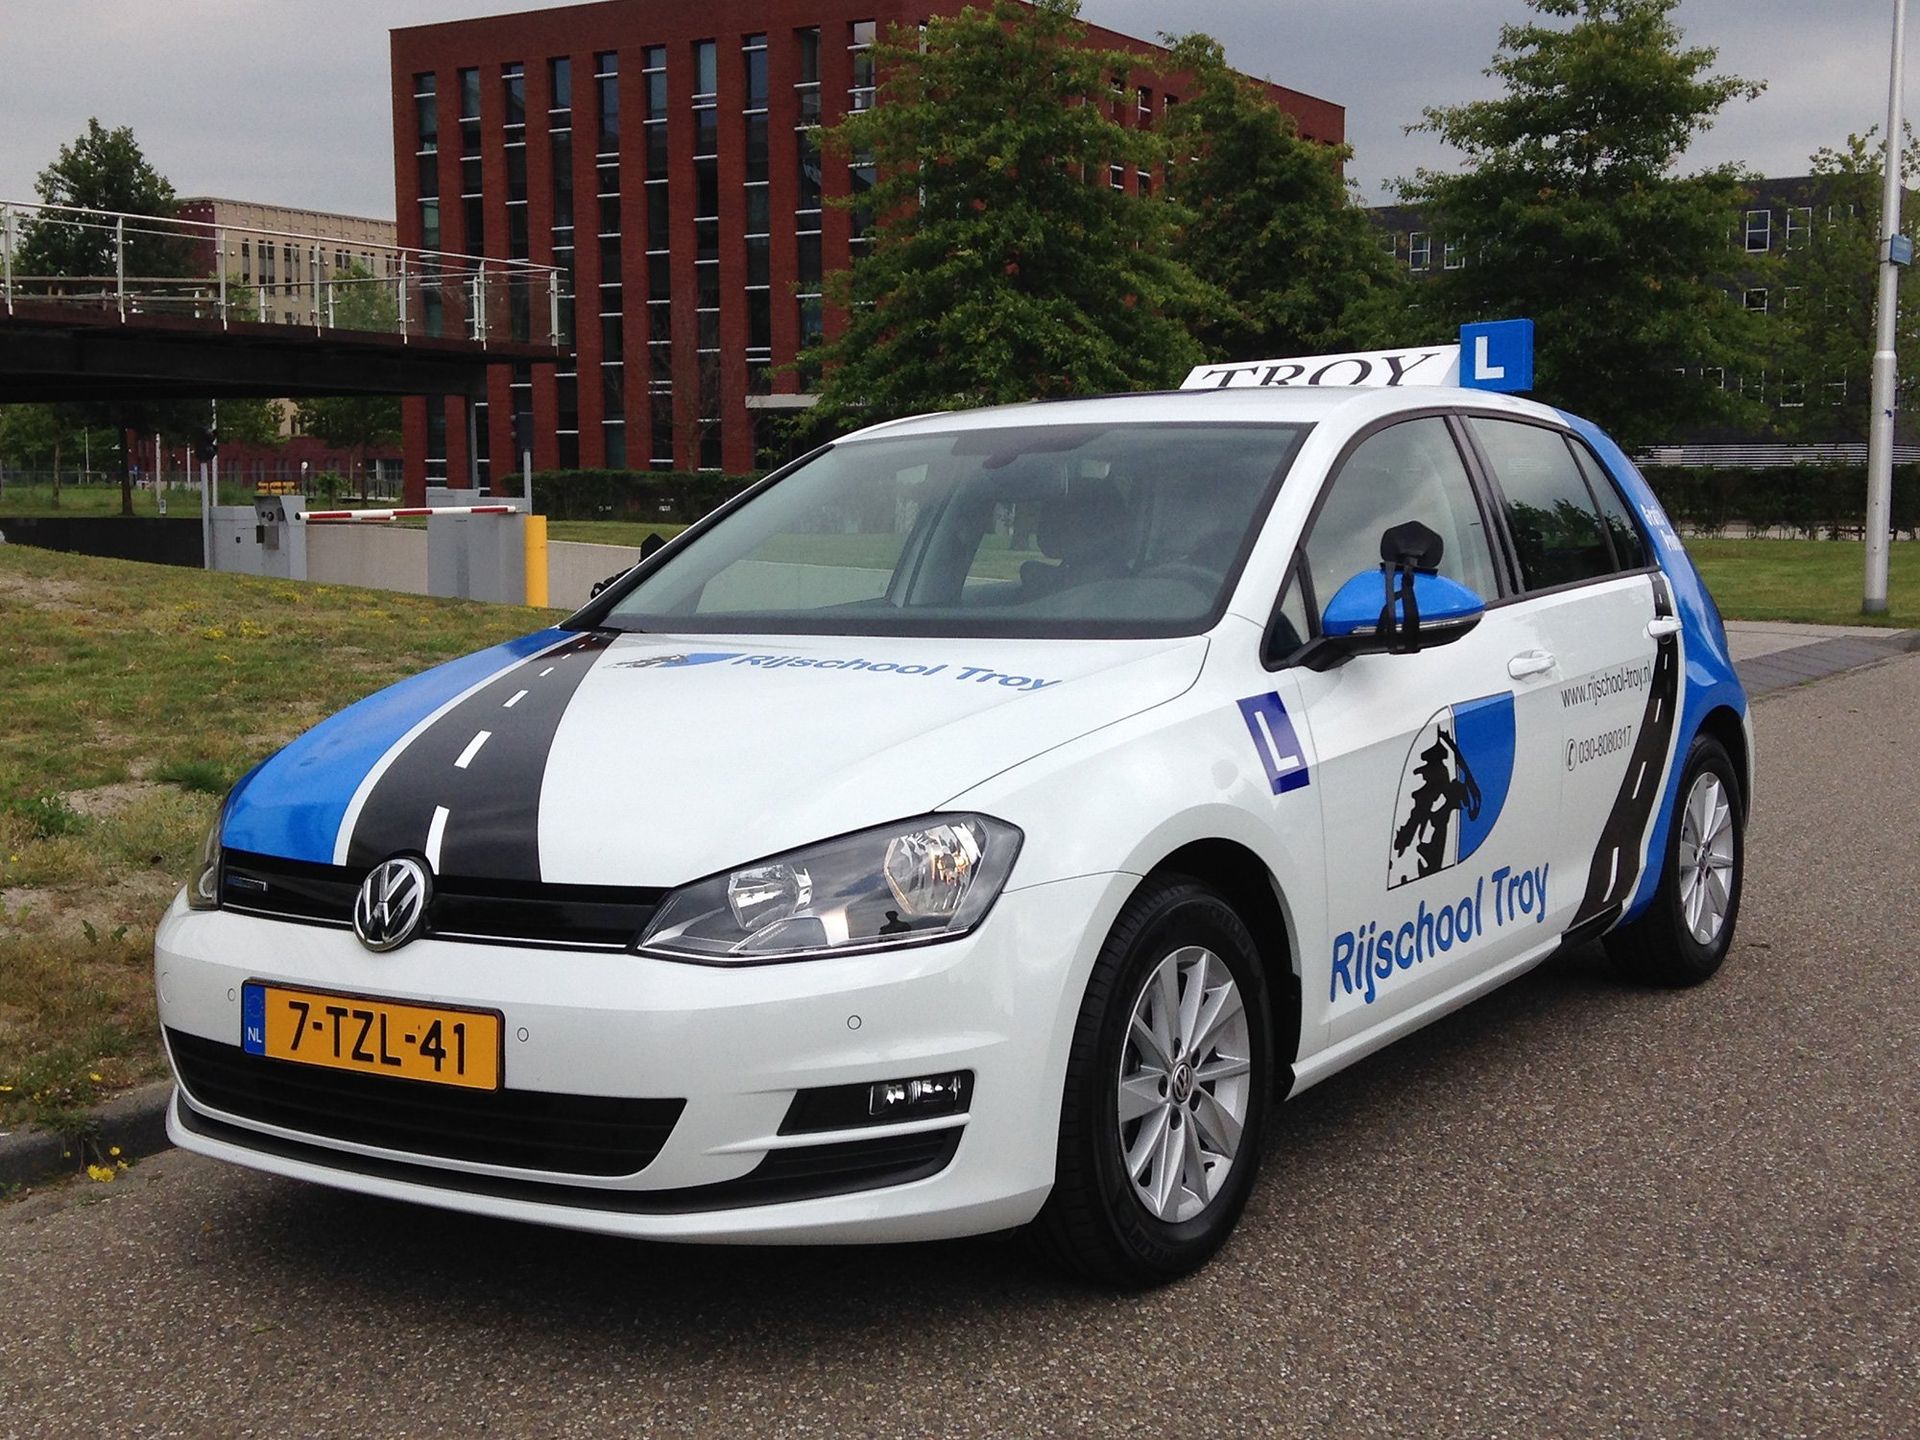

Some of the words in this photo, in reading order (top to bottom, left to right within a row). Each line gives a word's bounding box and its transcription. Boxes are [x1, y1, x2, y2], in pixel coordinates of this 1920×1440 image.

[1203, 353, 1440, 386] TROY
[1475, 336, 1504, 379] L
[732, 655, 947, 676] Rijschool
[956, 667, 1062, 691] Troy
[1561, 661, 1651, 707] www.rijschool-troy.nl
[1253, 710, 1301, 772] L
[1579, 726, 1632, 763] 030-8080317
[1329, 875, 1484, 1005] Rijschool
[1491, 862, 1550, 924] Troy
[247, 1027, 263, 1045] NL
[288, 1000, 466, 1076] 7-TZL-41
